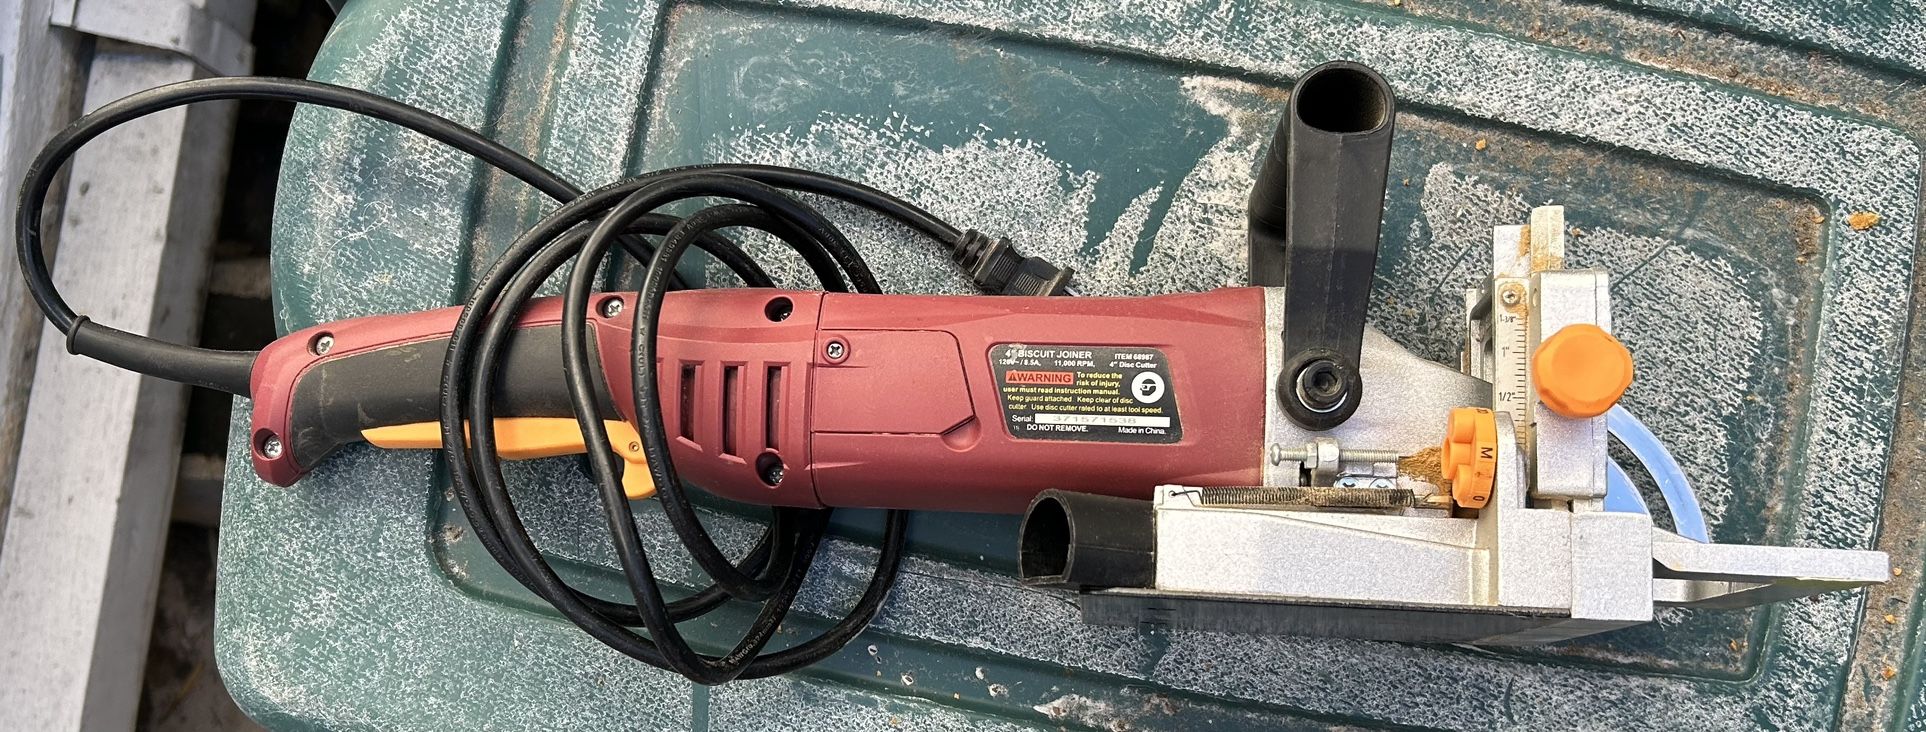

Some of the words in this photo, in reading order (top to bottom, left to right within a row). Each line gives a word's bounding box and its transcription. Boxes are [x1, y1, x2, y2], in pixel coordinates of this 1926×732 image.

[1018, 349, 1055, 358] BISCUIT
[1056, 350, 1093, 359] JOINER
[1502, 346, 1510, 357] 1"
[1133, 353, 1154, 361] 68987
[1017, 373, 1072, 383] WARNING
[1007, 394, 1024, 402] Keep
[1498, 392, 1516, 402] 1/2"
[1012, 414, 1034, 422] Serial:
[1480, 447, 1494, 459] M
